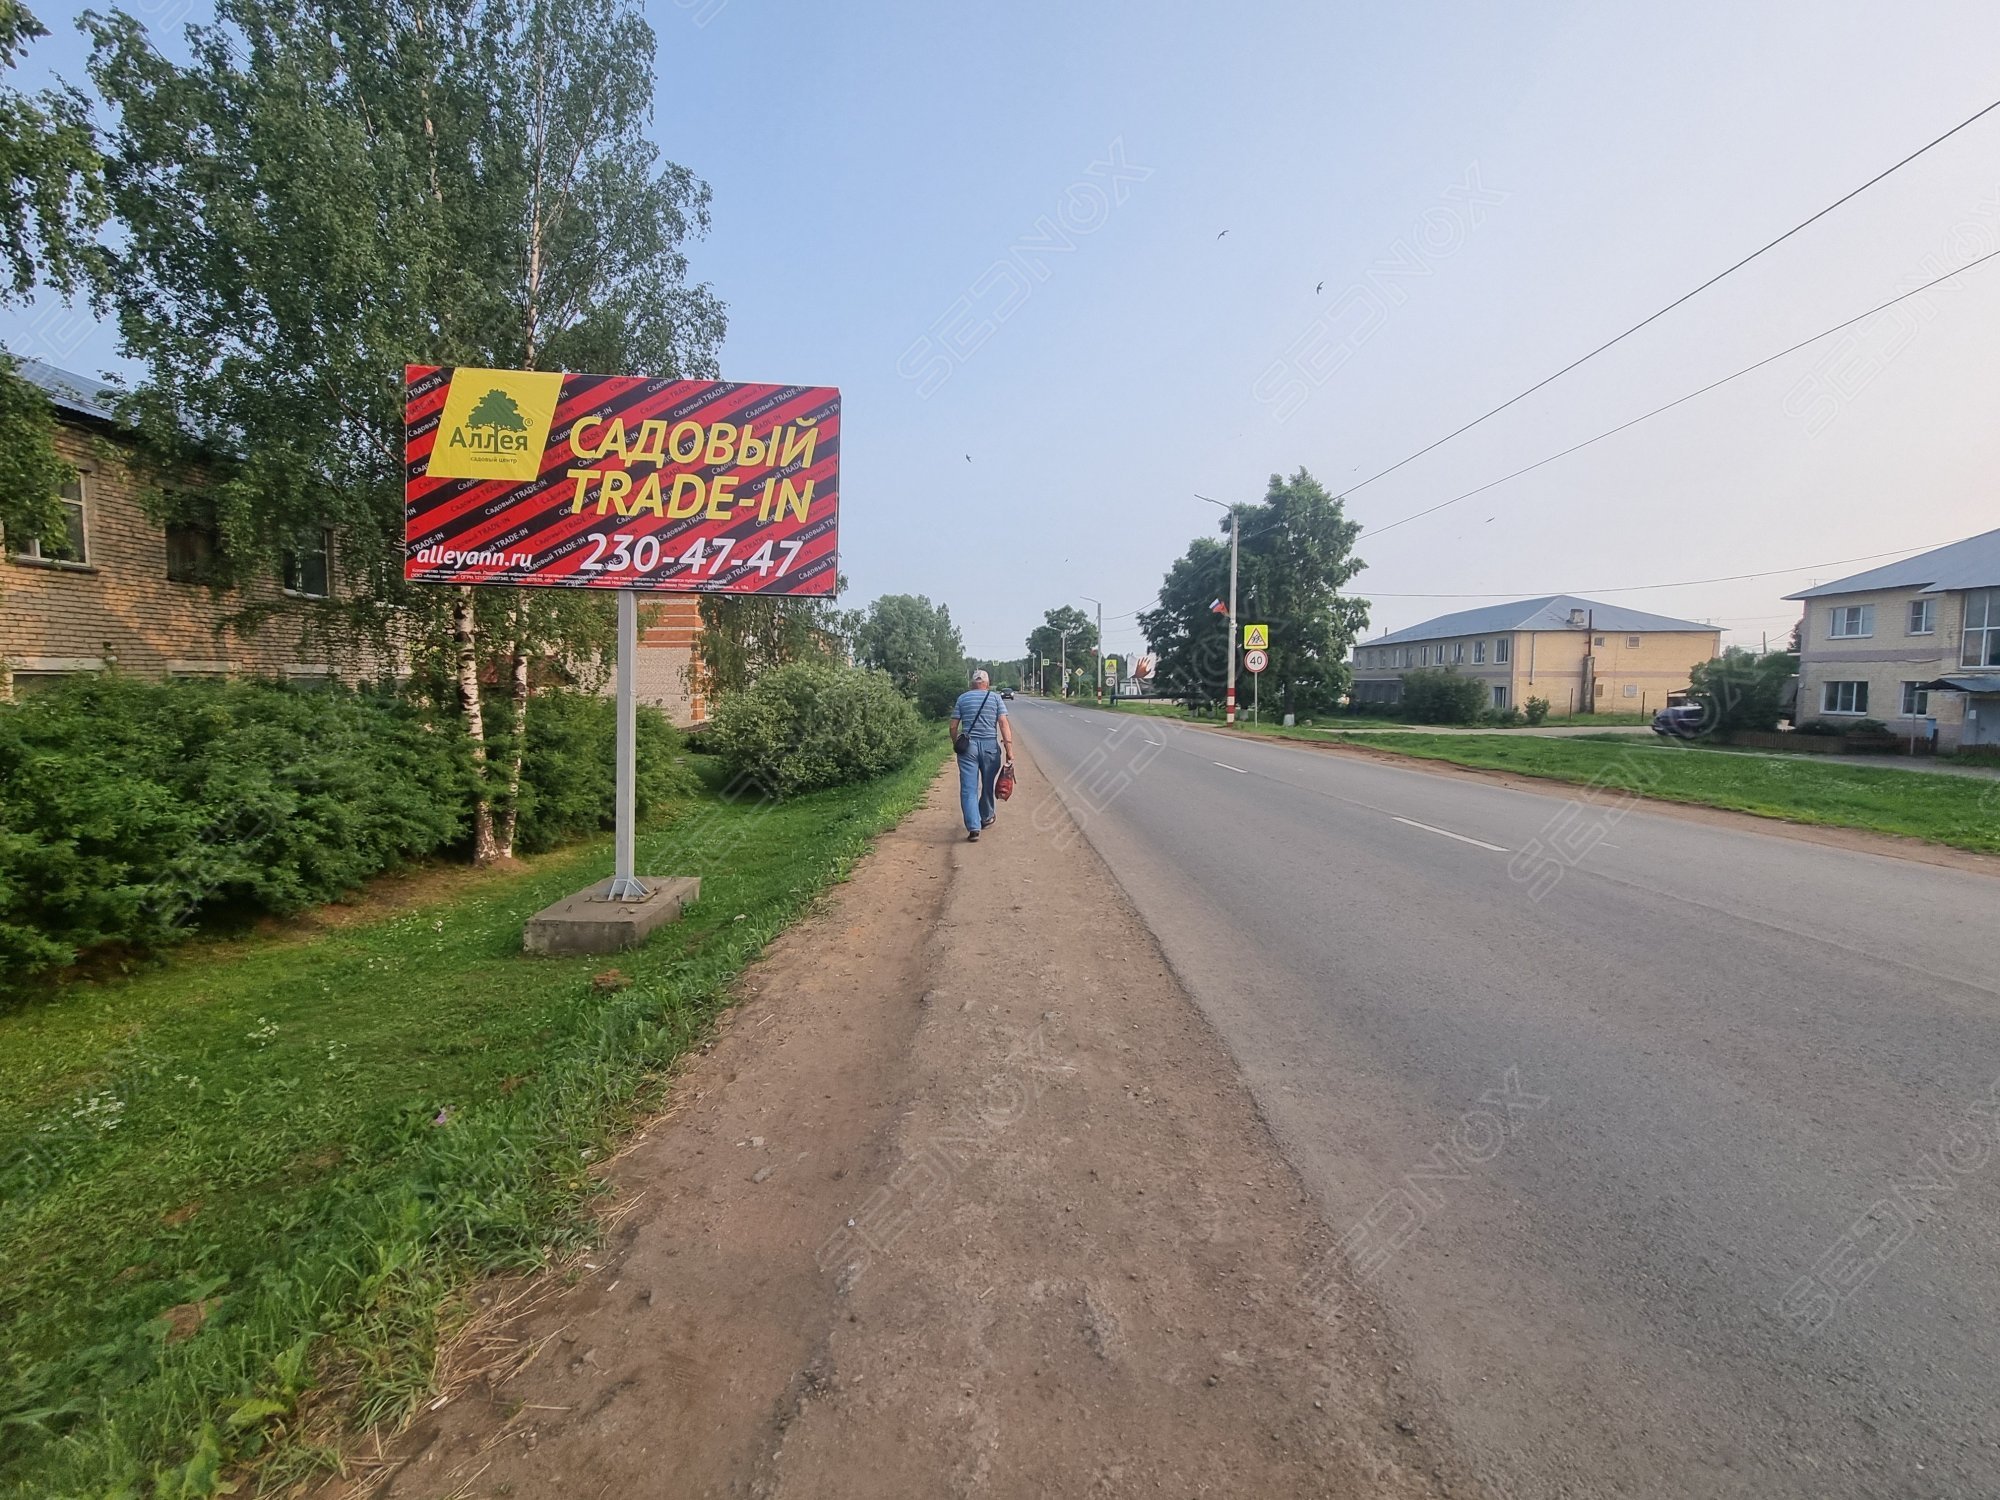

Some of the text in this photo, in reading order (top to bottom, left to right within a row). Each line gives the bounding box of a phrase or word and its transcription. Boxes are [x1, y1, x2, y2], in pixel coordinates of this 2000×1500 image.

[673, 397, 704, 418] Садовый
[703, 382, 736, 402] TRADE-IN
[744, 398, 775, 419] Садовый
[407, 416, 439, 438] Садовый
[449, 426, 528, 452] Аллея
[569, 417, 818, 468] САДОВЫЙ
[484, 496, 515, 516] Садовый
[514, 479, 548, 501] TRADE-IN
[566, 469, 815, 523] TRADE-IN
[411, 531, 445, 553] TRADE-IN
[495, 527, 529, 549] TRADE-IN
[658, 522, 687, 541] Садовый
[416, 545, 533, 569] alleyann.ru
[553, 536, 587, 557] TRADE-IN
[580, 532, 803, 577] 230-47-47
[798, 560, 828, 580] Садовый
[1249, 655, 1263, 665] 40
